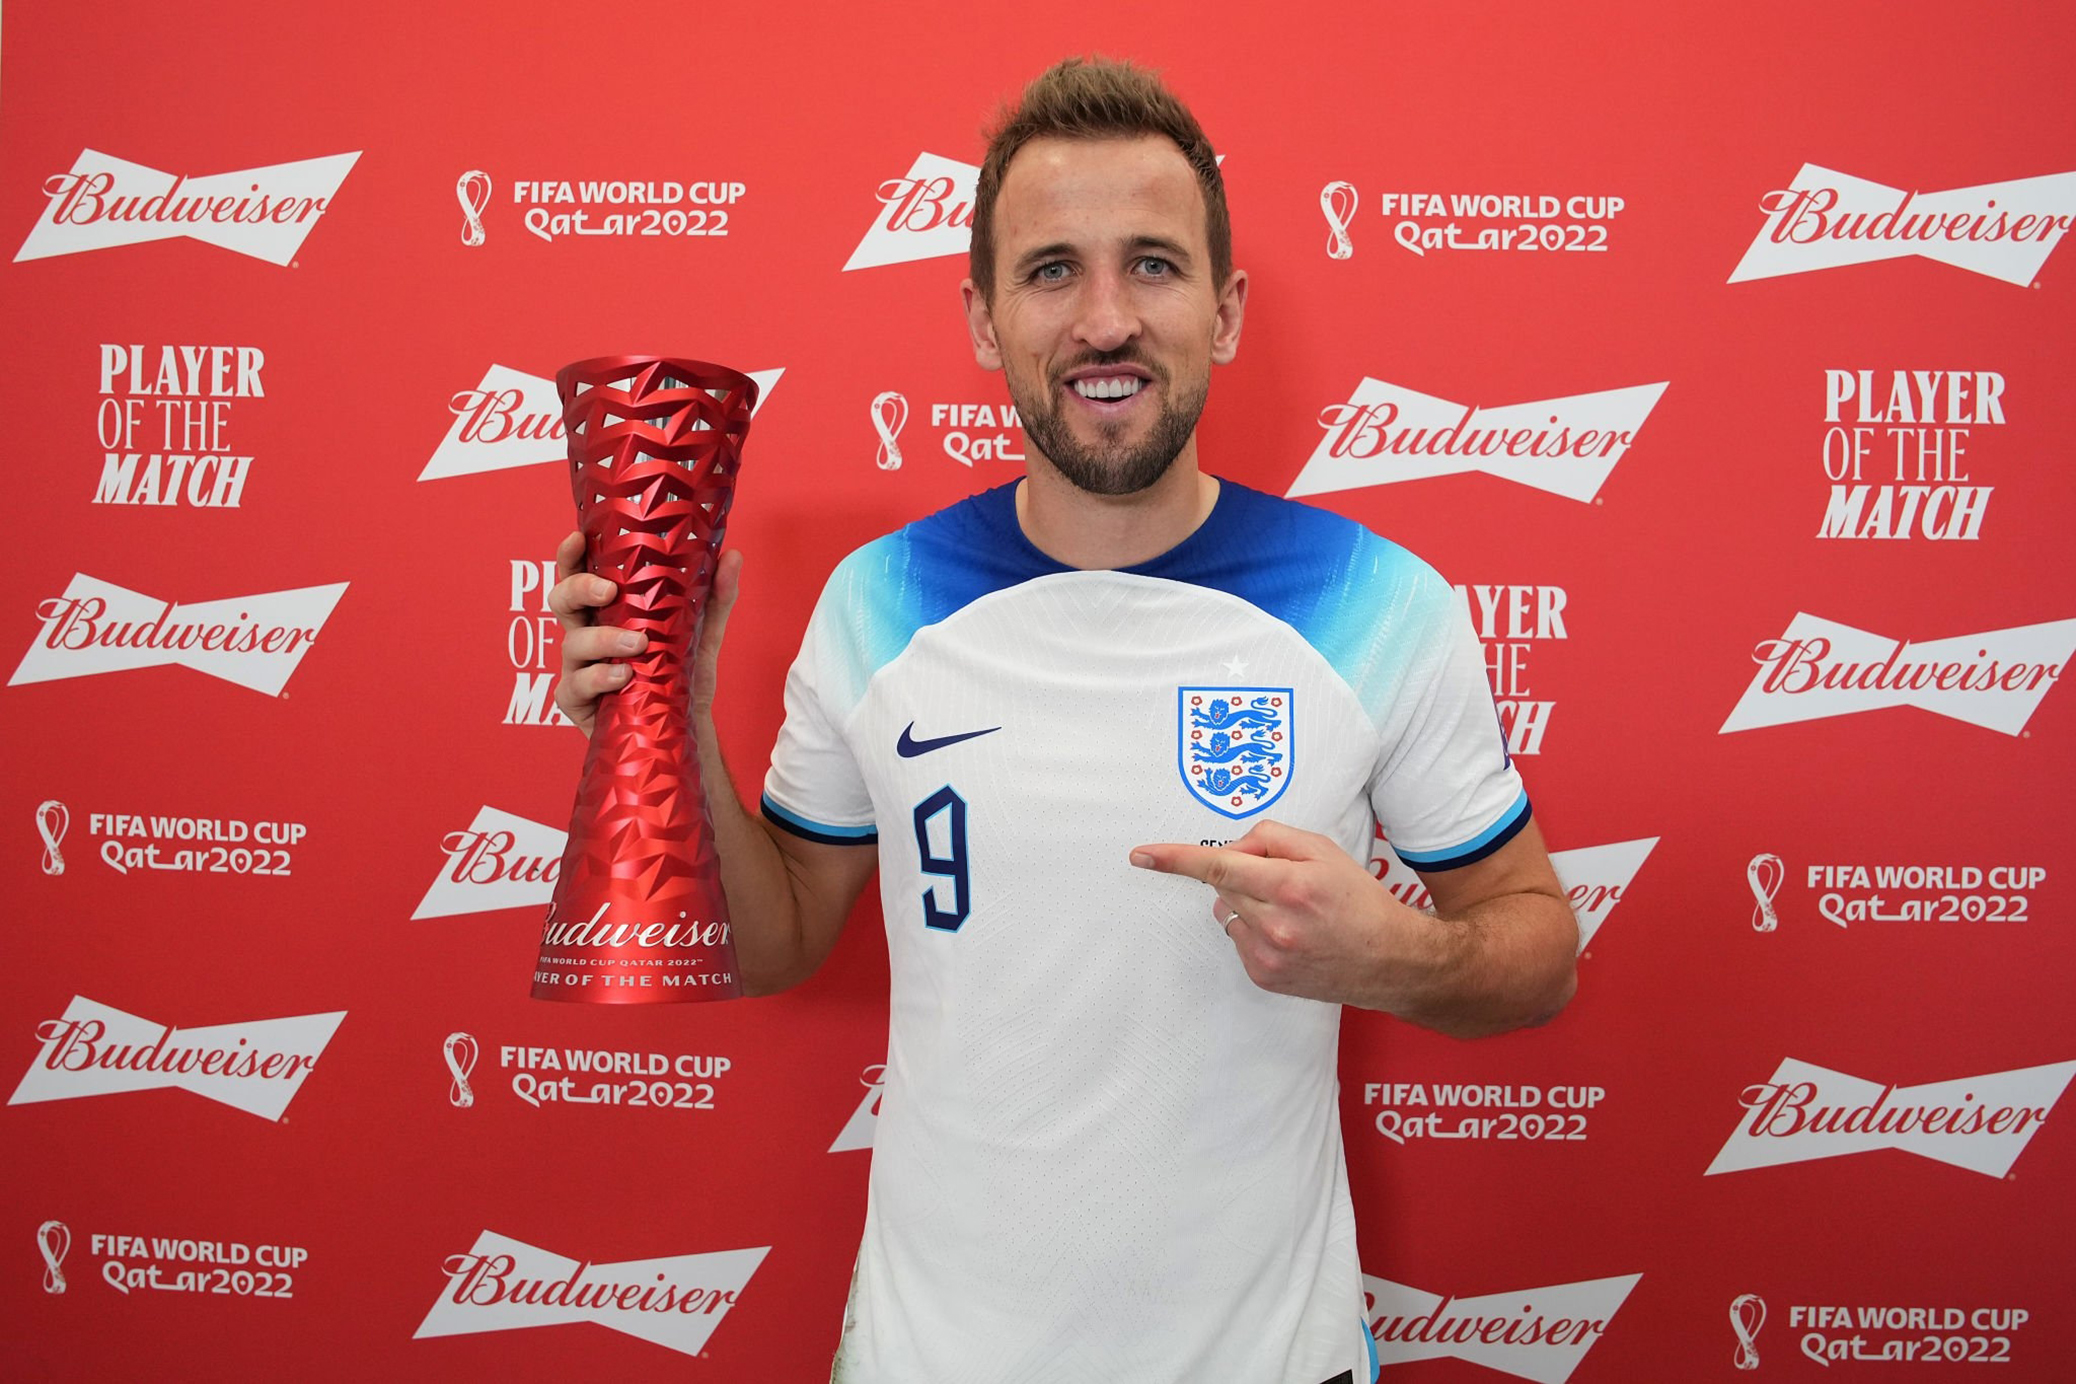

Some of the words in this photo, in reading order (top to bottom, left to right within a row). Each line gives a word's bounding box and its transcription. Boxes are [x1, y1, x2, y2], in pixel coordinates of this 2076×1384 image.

[42, 171, 327, 225] Budweiser
[515, 182, 575, 203] FIFA
[579, 182, 683, 204] WORLD
[689, 182, 745, 204] CUP
[1383, 194, 1447, 216] FIFA
[1451, 195, 1560, 218] WORLD
[1567, 196, 1624, 219] CUP
[1759, 187, 2069, 245] Budweiser
[100, 345, 264, 397] PLAYER
[1825, 370, 2005, 424] PLAYER
[98, 399, 144, 450] OF
[156, 401, 230, 451] THE
[932, 404, 996, 427] FIFA
[1317, 402, 1631, 459] Budweiser
[92, 454, 254, 507] MATCH
[1823, 427, 1874, 481] OF
[1888, 428, 1969, 482] THE
[1816, 485, 1994, 540] MATCH
[35, 597, 315, 654] Budweiser
[508, 616, 557, 668] OF
[1481, 643, 1531, 696] HE
[1752, 637, 2058, 695] Budweiser
[91, 814, 147, 837] FIFA
[151, 817, 248, 842] WORLD
[254, 822, 306, 844] CUP
[913, 783, 971, 933] 9
[1808, 866, 1870, 888] FIFA
[1875, 866, 1982, 889] WORLD
[1989, 867, 2046, 889] CUP
[552, 958, 587, 966] WORLD
[590, 958, 615, 966] CUP
[565, 973, 594, 986] OF
[602, 975, 652, 987] THE
[662, 972, 732, 987] MATCH
[35, 1020, 314, 1080] Budweiser
[501, 1046, 561, 1070] FIFA
[565, 1050, 669, 1075] WORLD
[675, 1055, 731, 1078] CUP
[1365, 1084, 1428, 1105] FIFA
[1433, 1085, 1541, 1107] WORLD
[1548, 1086, 1605, 1108] CUP
[1738, 1081, 2046, 1138] Budweiser
[92, 1235, 149, 1258] FIFA
[152, 1238, 250, 1264] WORLD
[256, 1245, 307, 1268] CUP
[441, 1254, 736, 1315] Budweiser
[1364, 1291, 1603, 1346] udweiser
[1790, 1306, 1853, 1328] FIFA
[1858, 1308, 1965, 1329] WORLD
[1972, 1309, 2028, 1330] CUP
